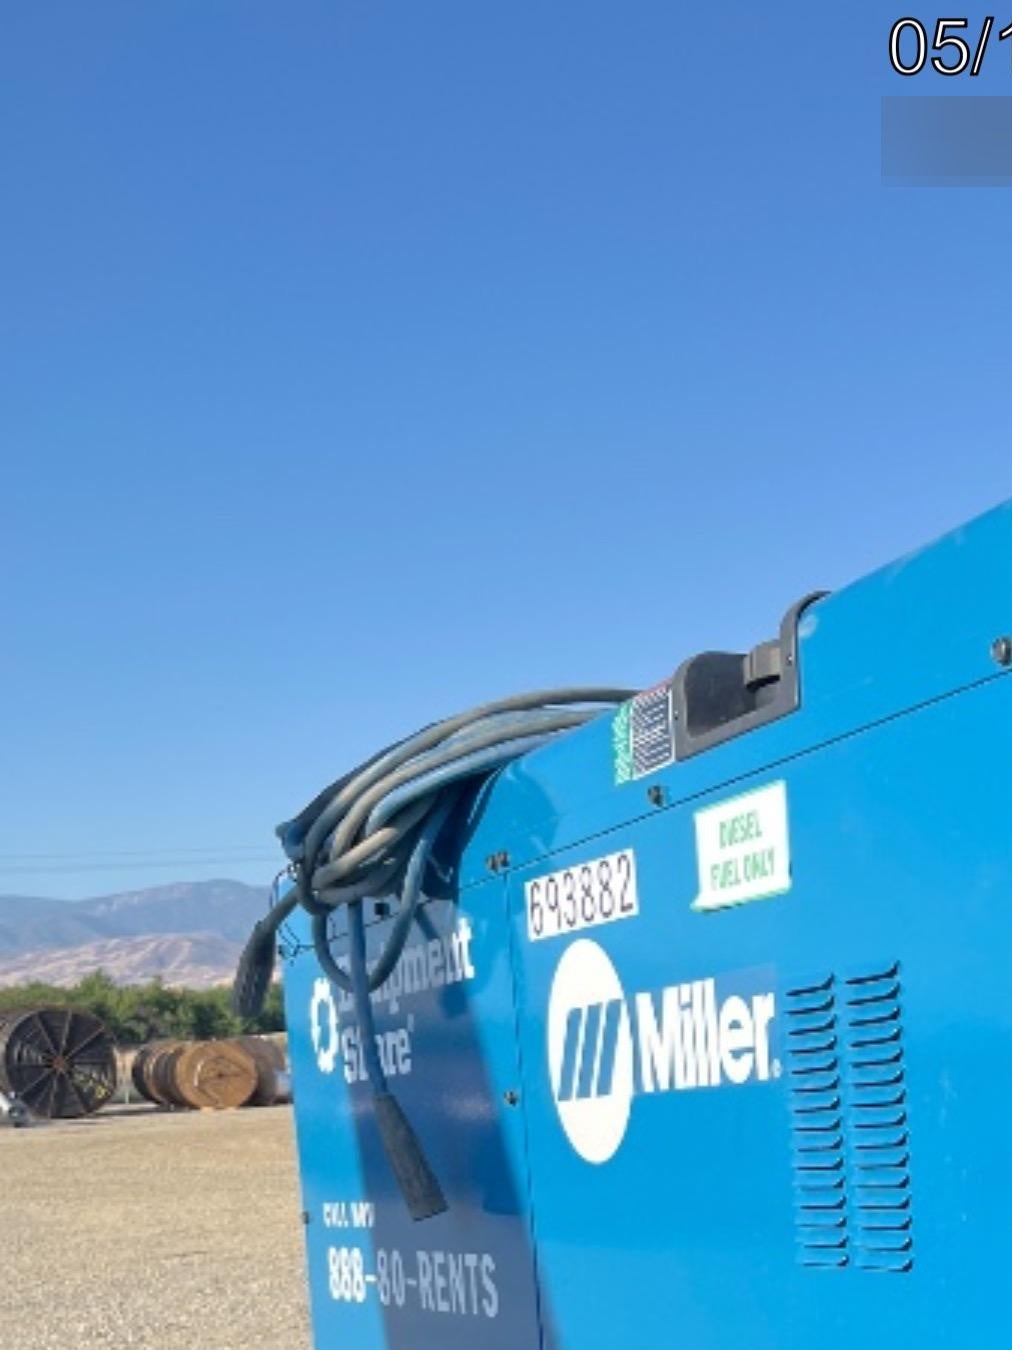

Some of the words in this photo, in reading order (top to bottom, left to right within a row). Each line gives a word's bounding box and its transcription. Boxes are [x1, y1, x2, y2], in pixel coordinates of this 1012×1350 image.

[718, 809, 763, 850] DIESEL
[529, 853, 634, 938] 693882
[710, 861, 741, 891] FUEL
[742, 847, 776, 883] ONLY
[327, 1245, 500, 1318] 888-80-RENTS
